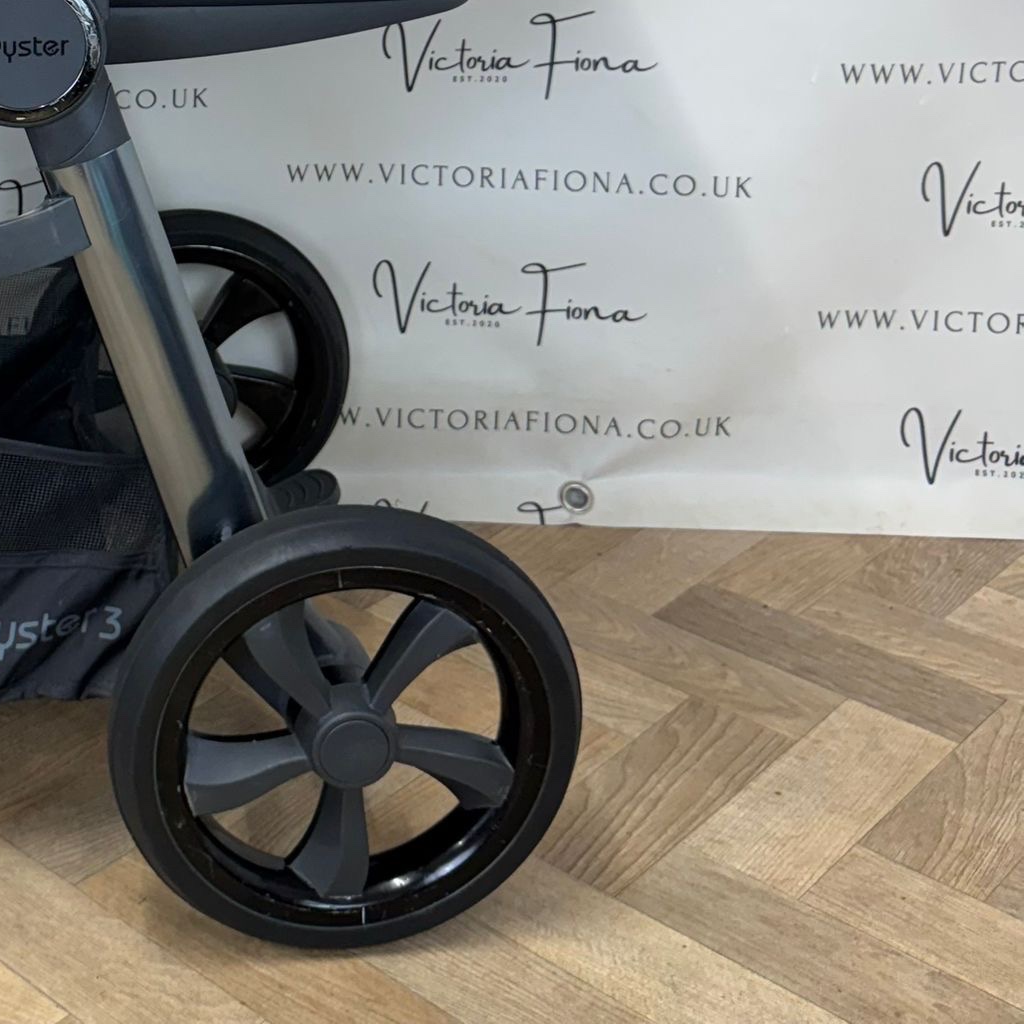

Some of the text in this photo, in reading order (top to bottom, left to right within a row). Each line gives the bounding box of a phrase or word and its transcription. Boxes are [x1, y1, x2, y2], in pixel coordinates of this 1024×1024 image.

[382, 10, 659, 100] Victoria Fiona
[286, 163, 753, 199] WWW.VICTORIAFIONA.CO.UK
[373, 259, 648, 346] Victoria Fiona
